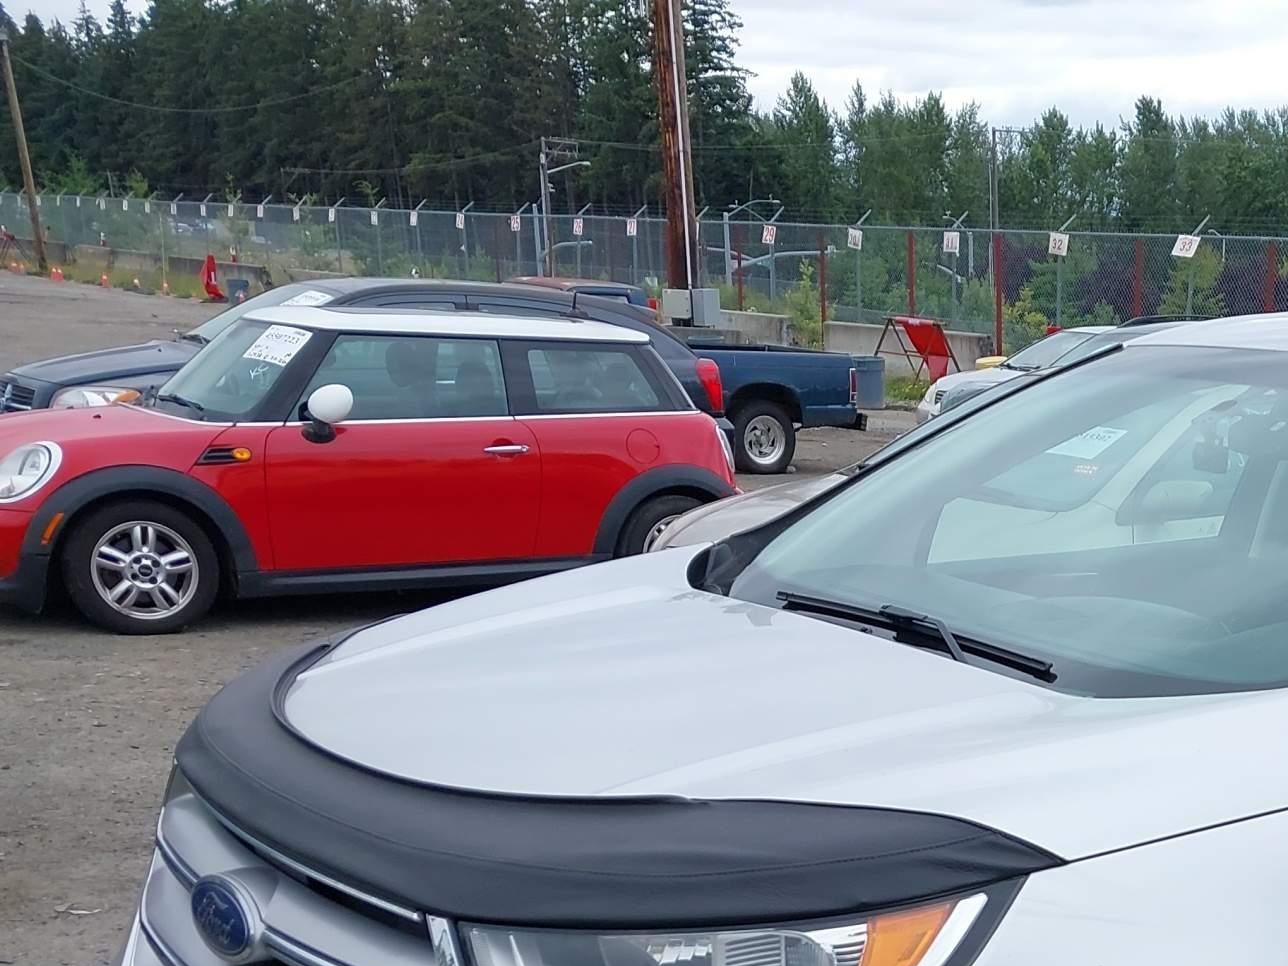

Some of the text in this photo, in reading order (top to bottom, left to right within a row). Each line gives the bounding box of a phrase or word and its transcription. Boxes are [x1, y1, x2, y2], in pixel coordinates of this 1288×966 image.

[511, 216, 520, 230] 25
[574, 219, 583, 234] 26
[628, 219, 636, 235] 27
[764, 226, 775, 243] 29
[1052, 238, 1063, 250] 32
[1179, 240, 1193, 252] 33
